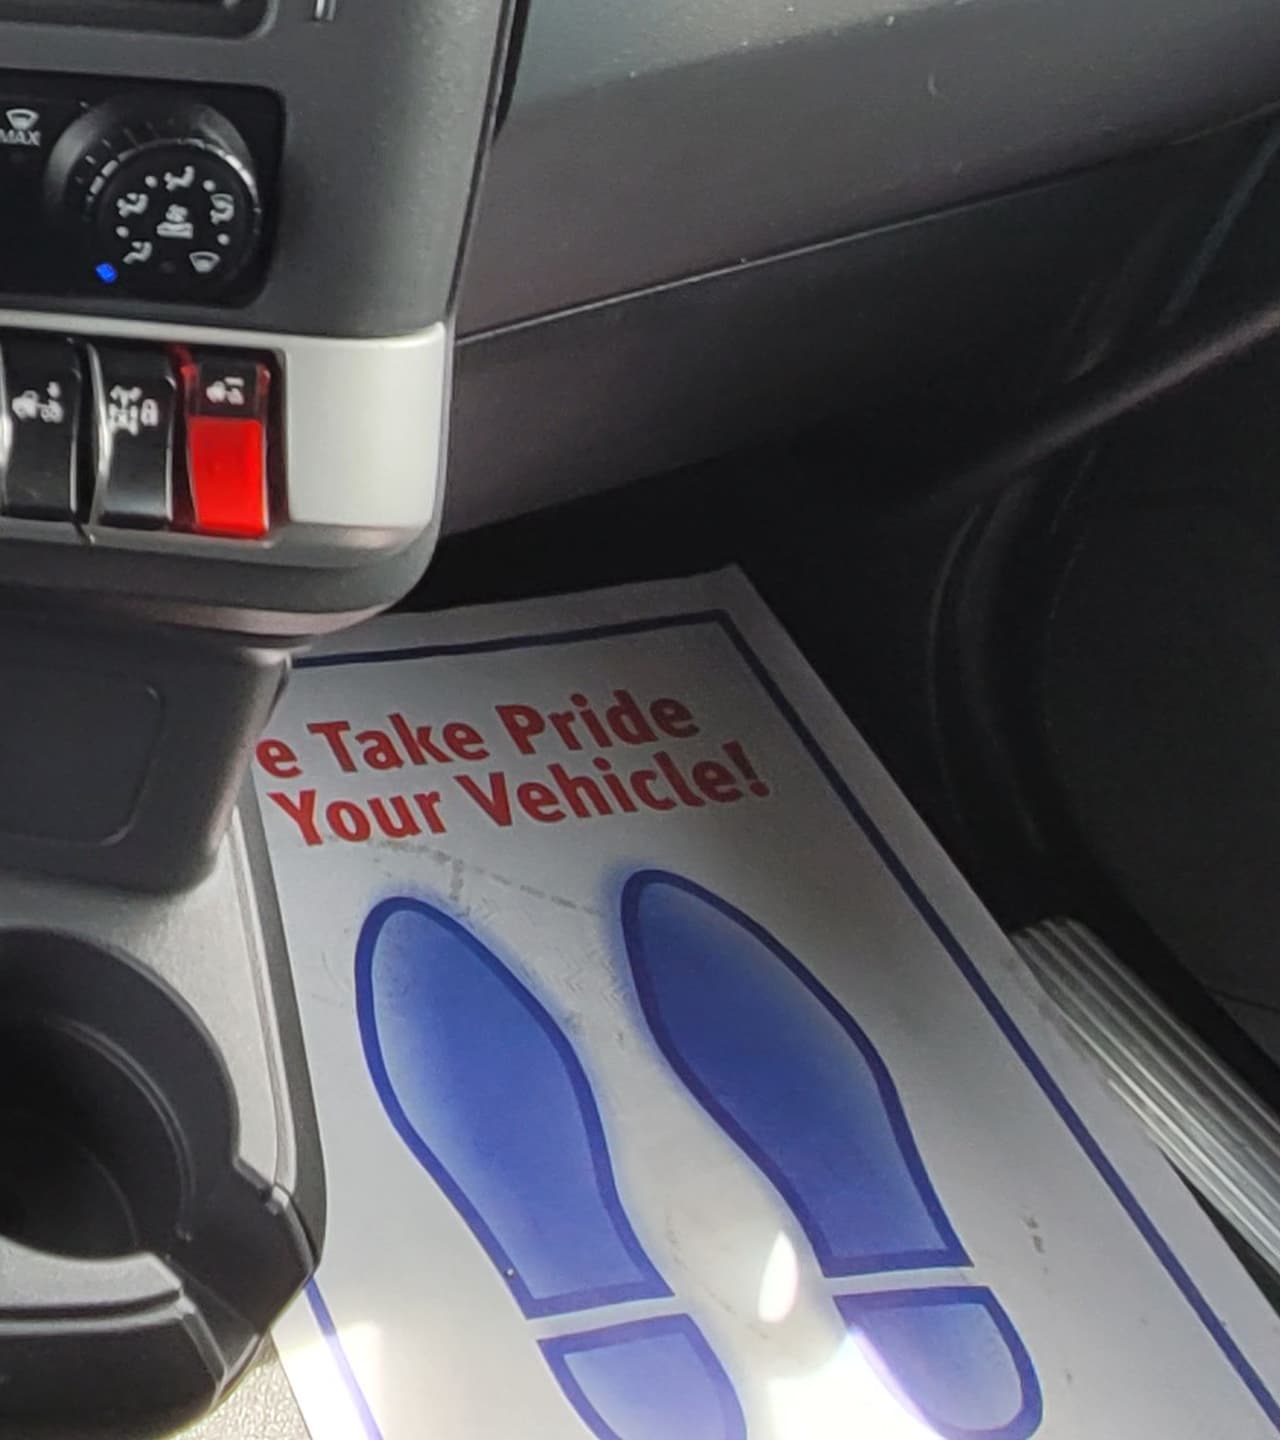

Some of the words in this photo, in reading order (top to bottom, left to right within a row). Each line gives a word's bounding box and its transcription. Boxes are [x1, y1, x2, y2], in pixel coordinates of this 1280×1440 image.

[257, 737, 302, 780] e
[306, 712, 487, 774] Take
[494, 688, 701, 760] Pride
[267, 788, 449, 849] Your
[456, 740, 773, 828] Vehicle!
